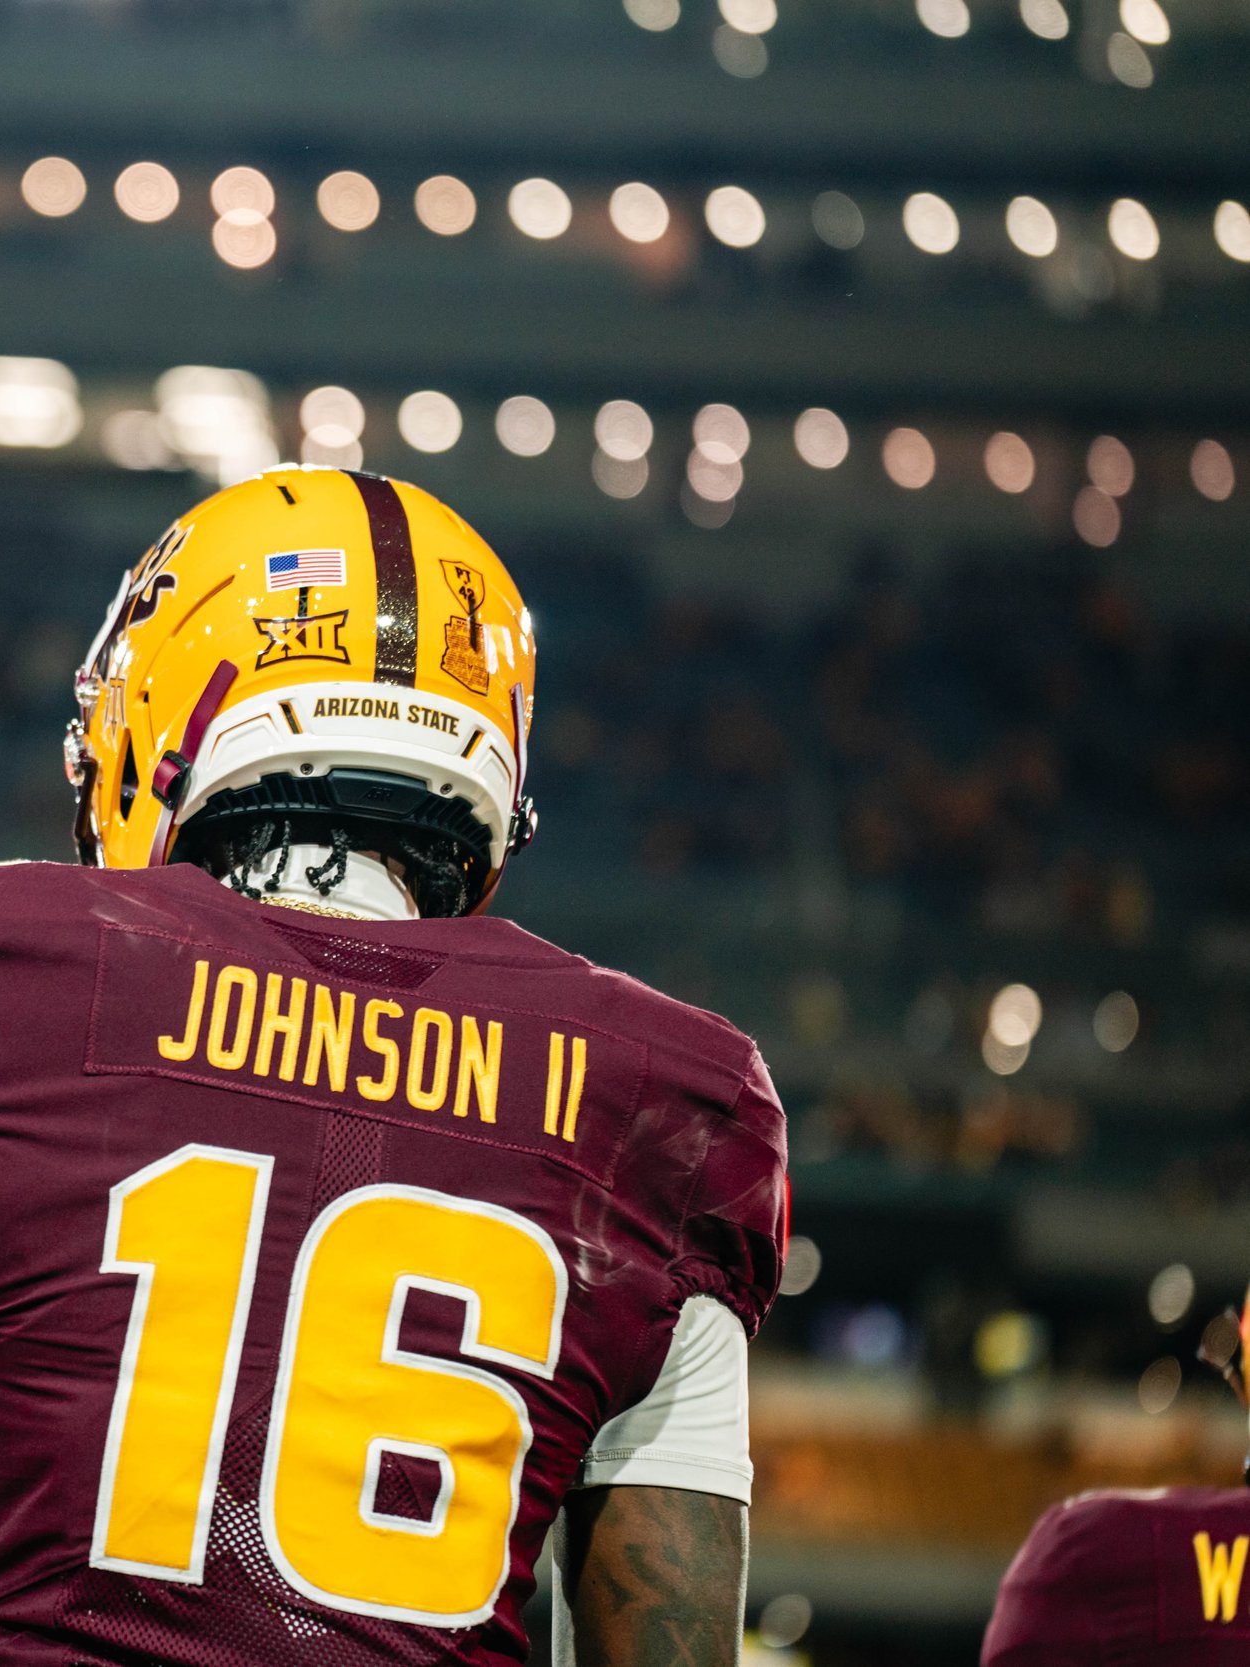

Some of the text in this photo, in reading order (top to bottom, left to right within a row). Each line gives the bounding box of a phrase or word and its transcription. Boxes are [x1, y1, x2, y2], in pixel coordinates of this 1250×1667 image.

[313, 697, 461, 737] ARIZONA STATE
[158, 960, 587, 1142] JOHNSON II
[89, 1143, 569, 1629] 16
